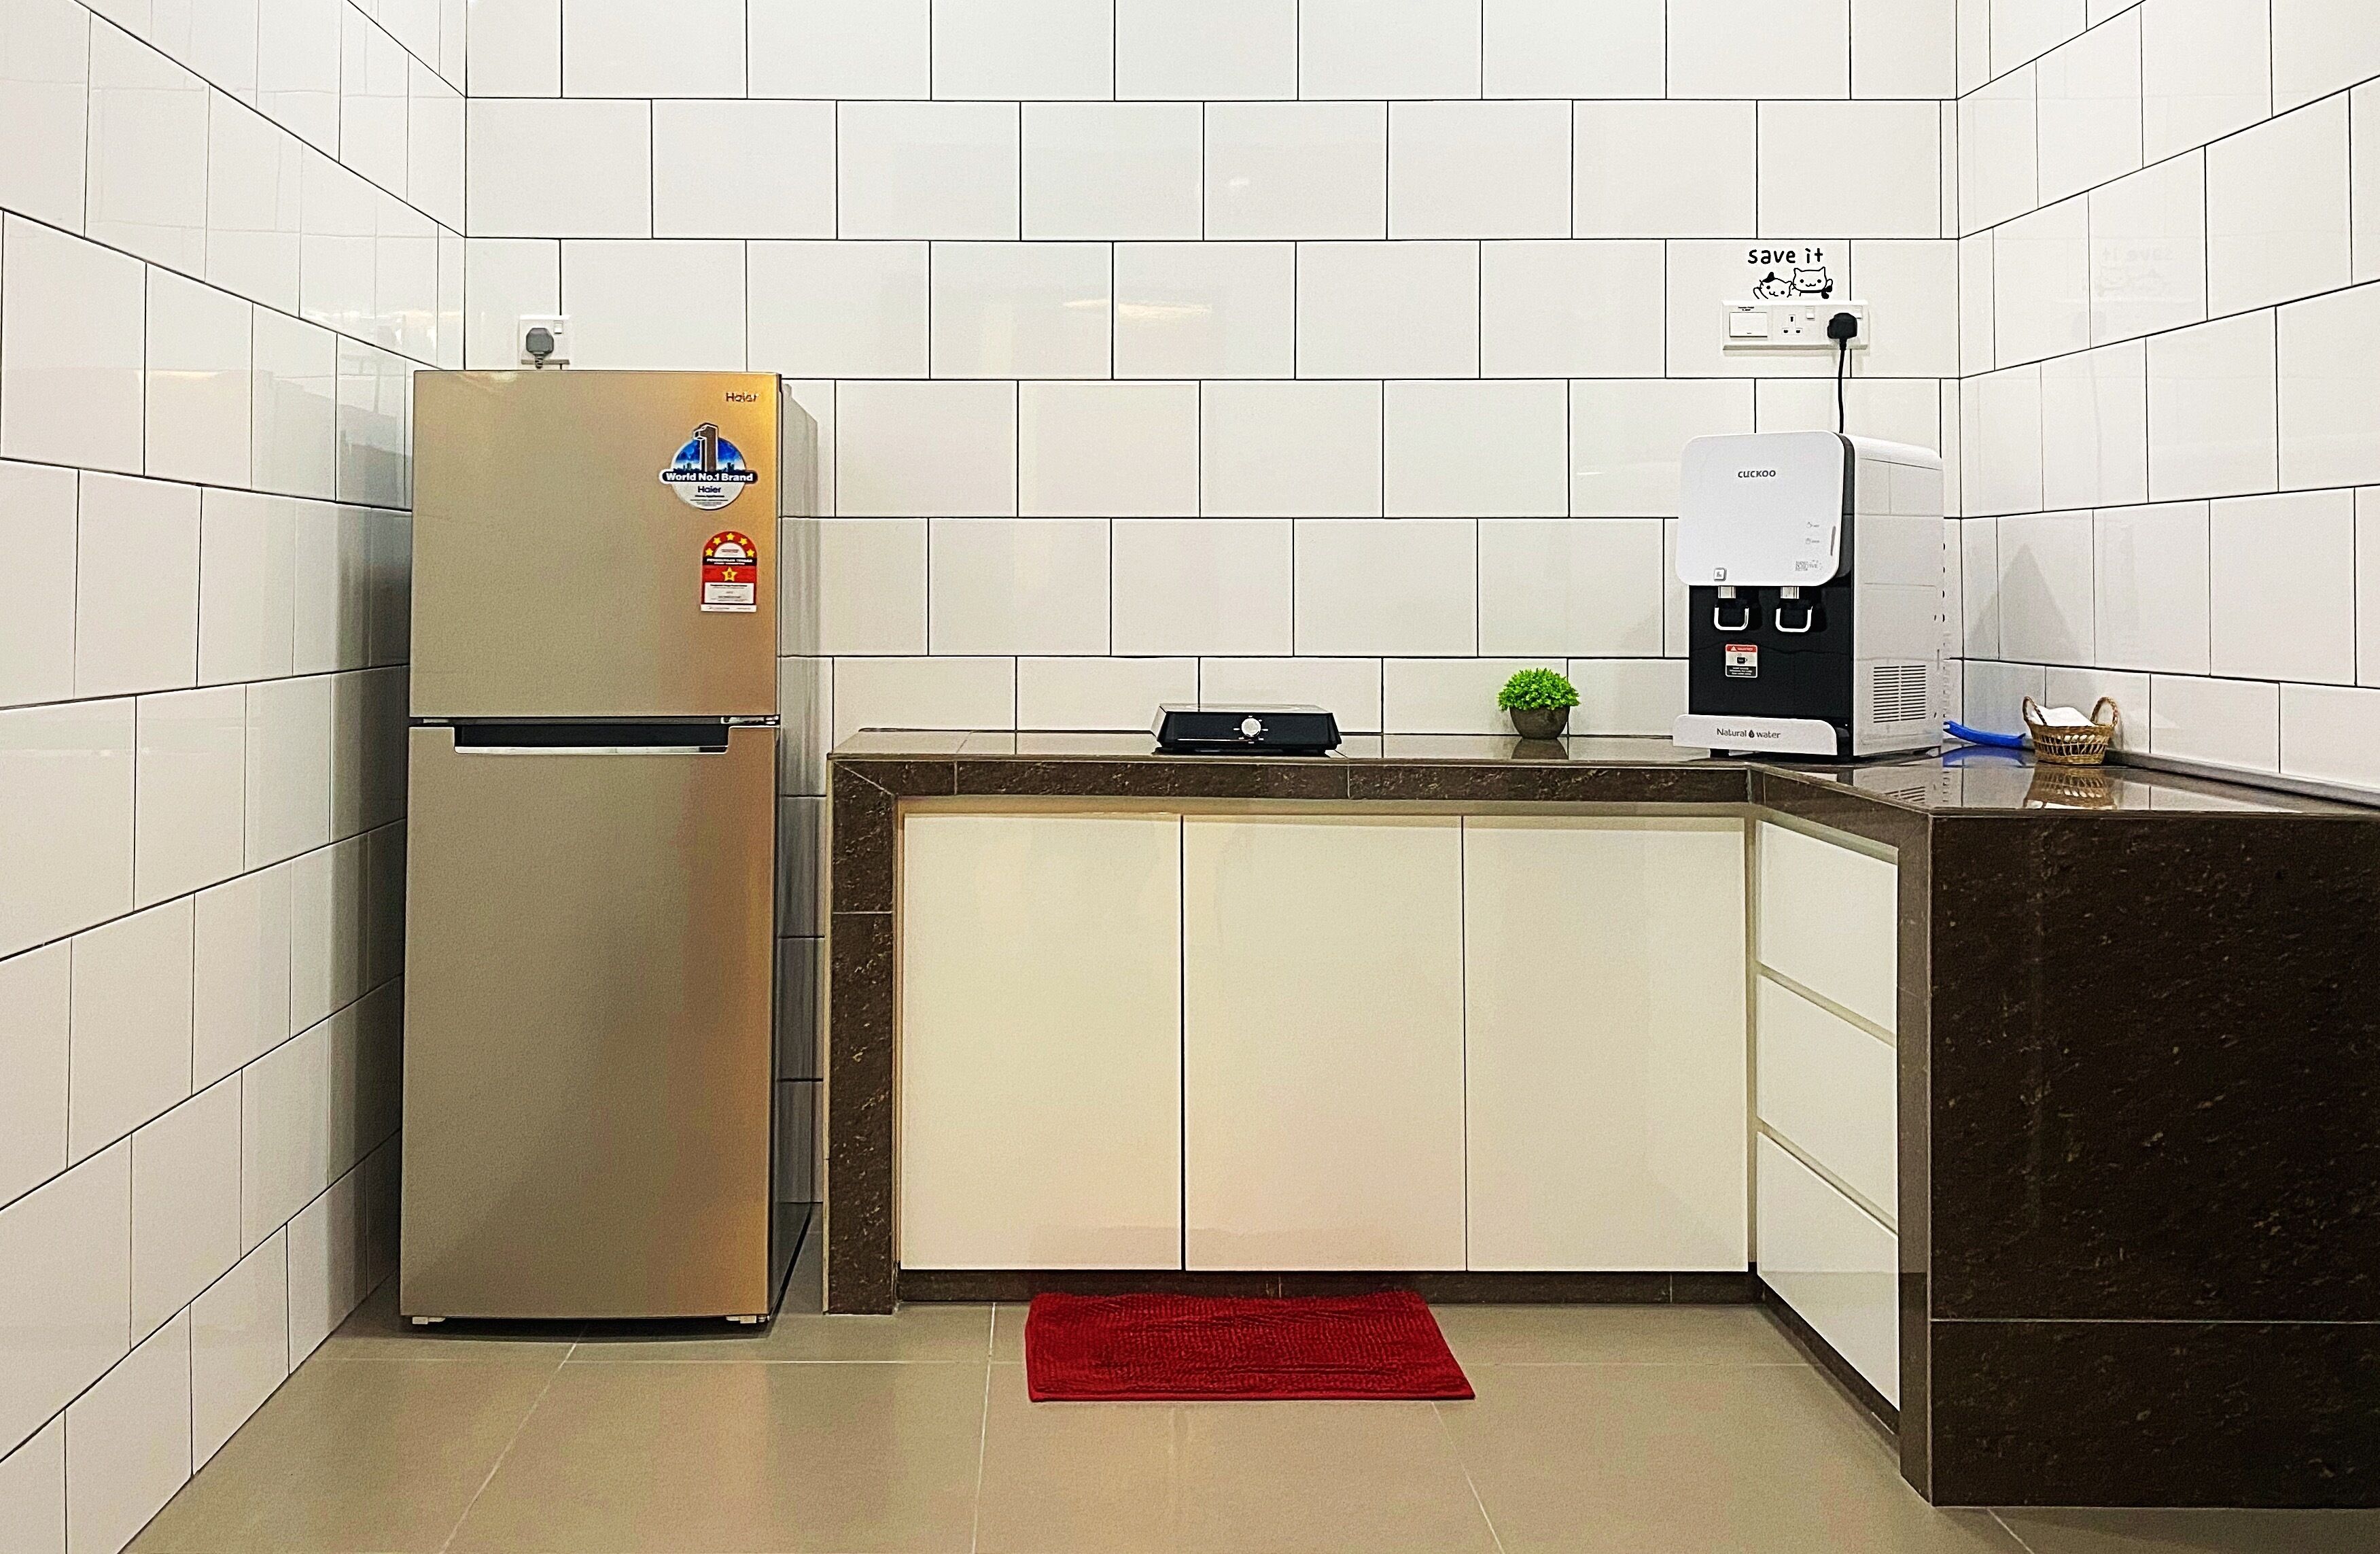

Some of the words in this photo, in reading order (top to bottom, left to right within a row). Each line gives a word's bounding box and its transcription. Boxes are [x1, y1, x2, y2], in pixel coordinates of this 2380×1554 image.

[1747, 249, 1796, 264] save
[1804, 247, 1823, 264] it
[726, 392, 757, 402] Haier
[666, 472, 697, 481] World
[698, 472, 720, 482] No.1
[721, 473, 754, 481] Brand
[1738, 470, 1777, 478] CUCKOO
[697, 485, 722, 494] Haier
[1716, 727, 1747, 738] Natural
[1755, 731, 1781, 739] water
